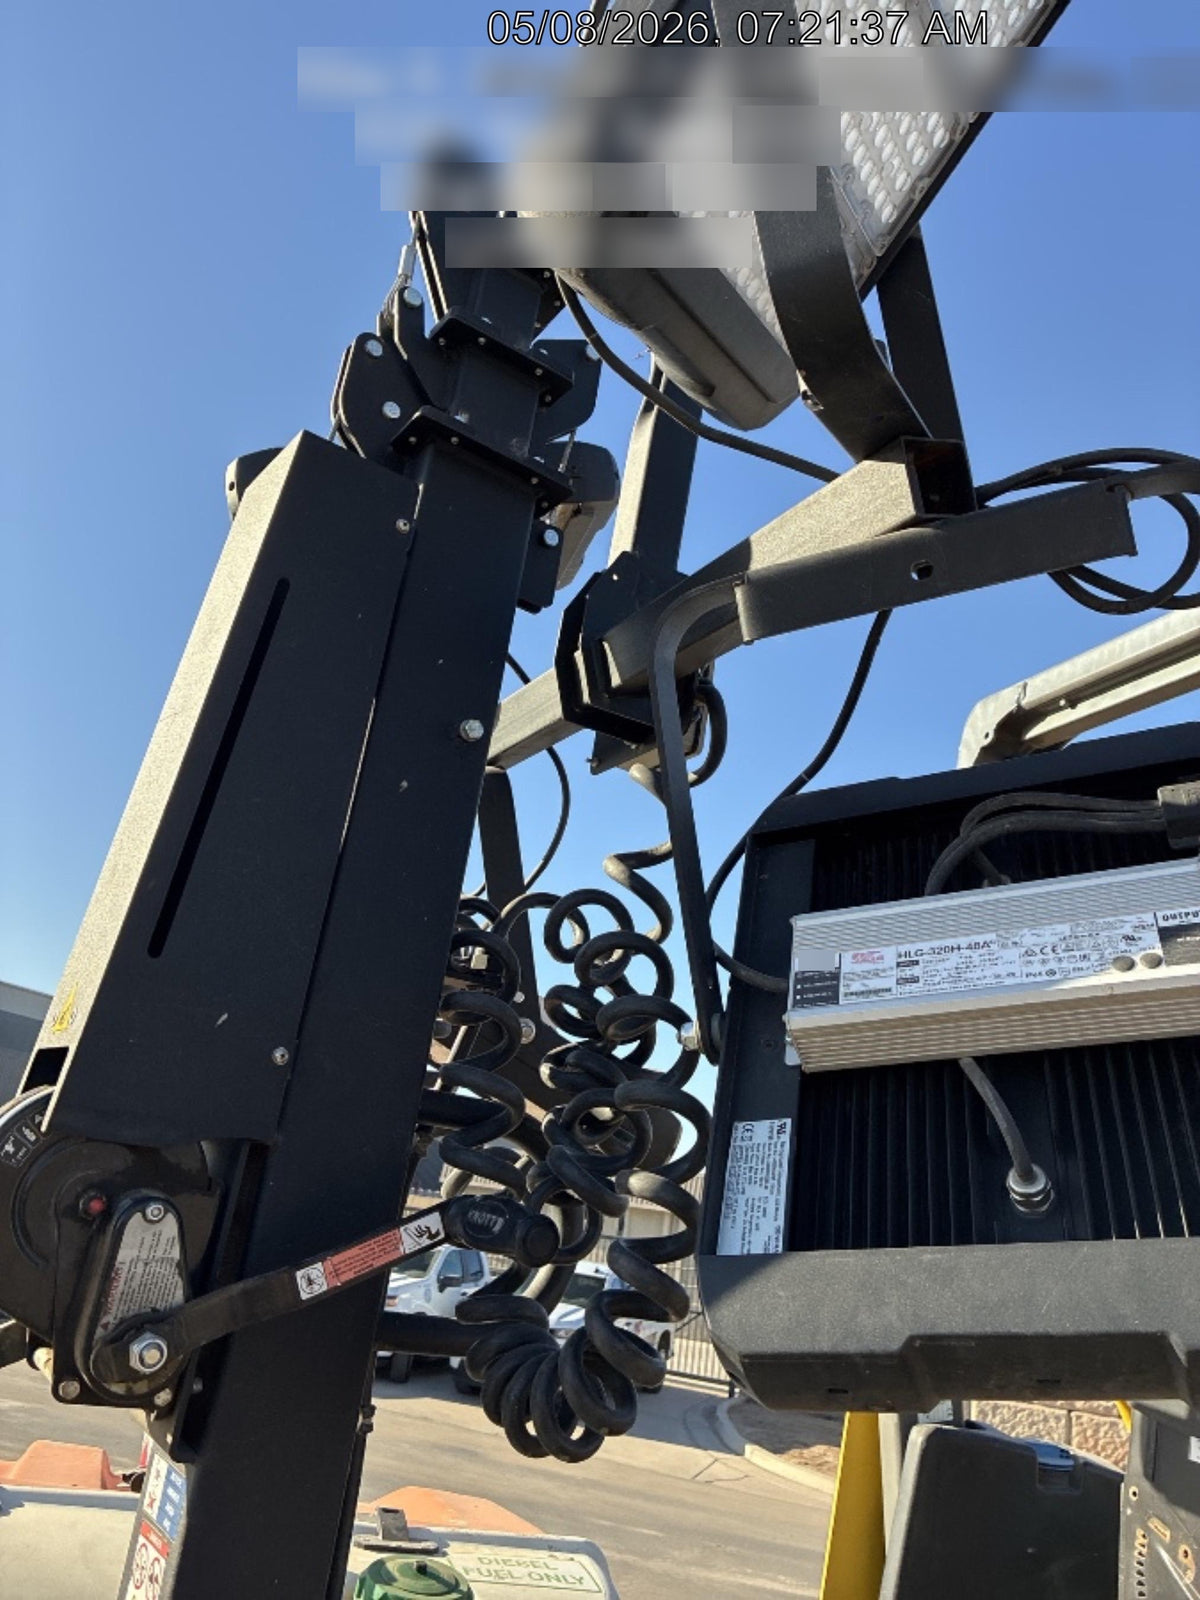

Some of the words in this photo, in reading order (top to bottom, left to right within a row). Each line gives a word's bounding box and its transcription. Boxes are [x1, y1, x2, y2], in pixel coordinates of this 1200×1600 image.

[477, 1556, 559, 1571] DIESEL
[462, 1566, 519, 1580] FUEL
[527, 1571, 585, 1586] ONLY
